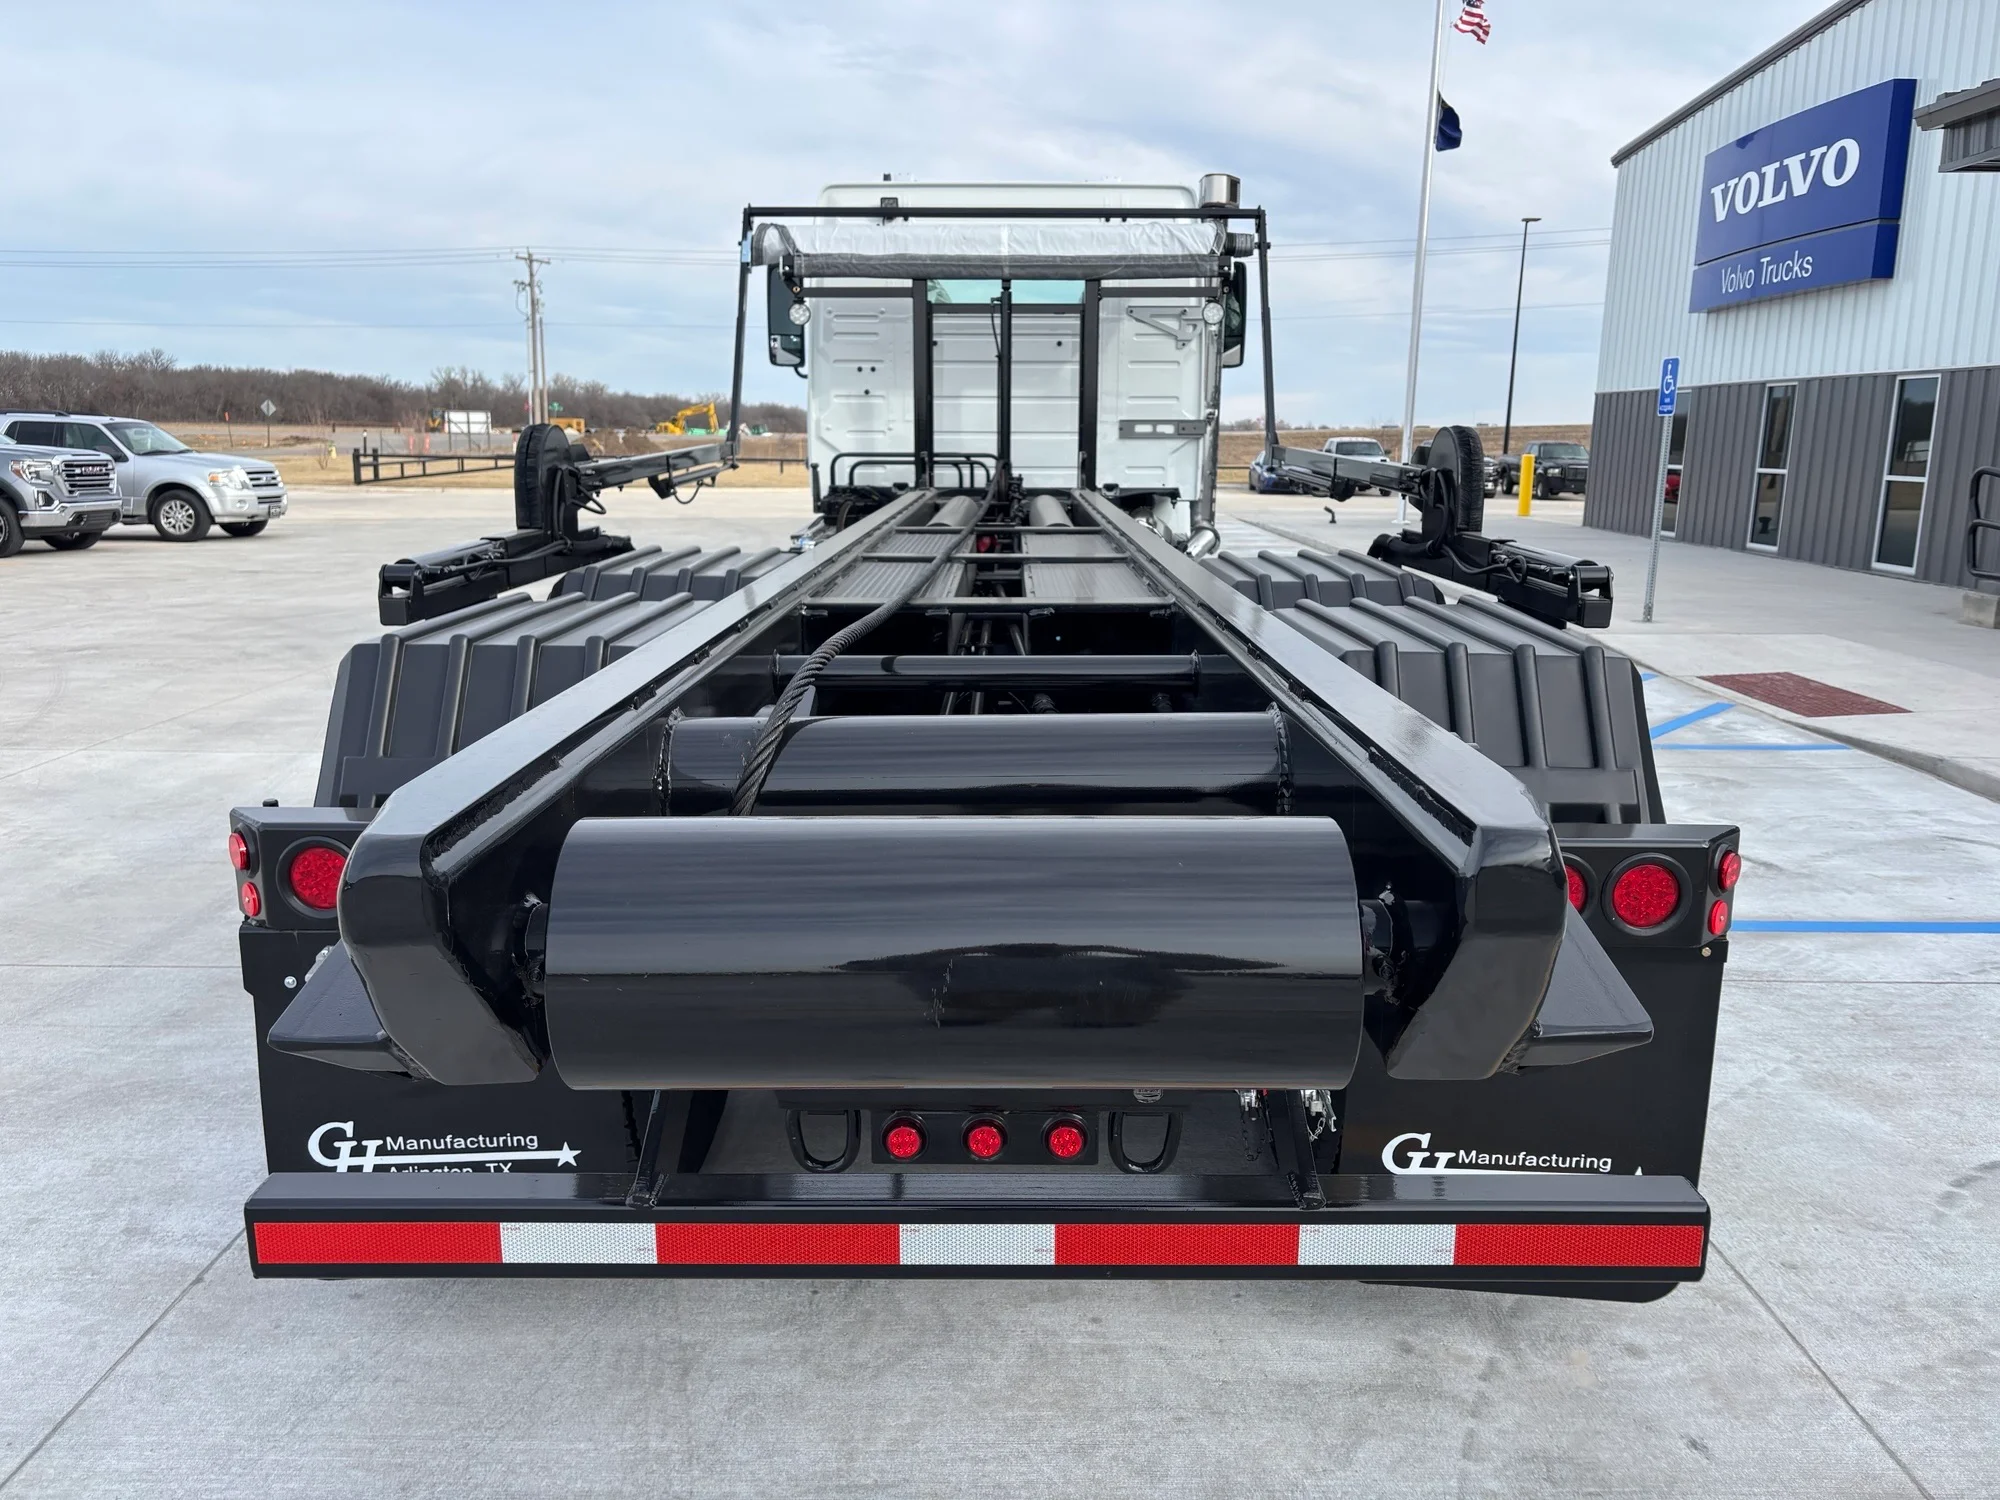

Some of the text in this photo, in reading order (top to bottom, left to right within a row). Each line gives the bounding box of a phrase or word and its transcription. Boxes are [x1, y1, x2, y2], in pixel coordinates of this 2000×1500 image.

[1710, 138, 1860, 223] VOLVO
[1721, 250, 1813, 294] Volvo Trucks
[386, 1133, 538, 1151] Manufacturing
[485, 1162, 512, 1173] TX
[1457, 1149, 1612, 1173] Manufacturing
